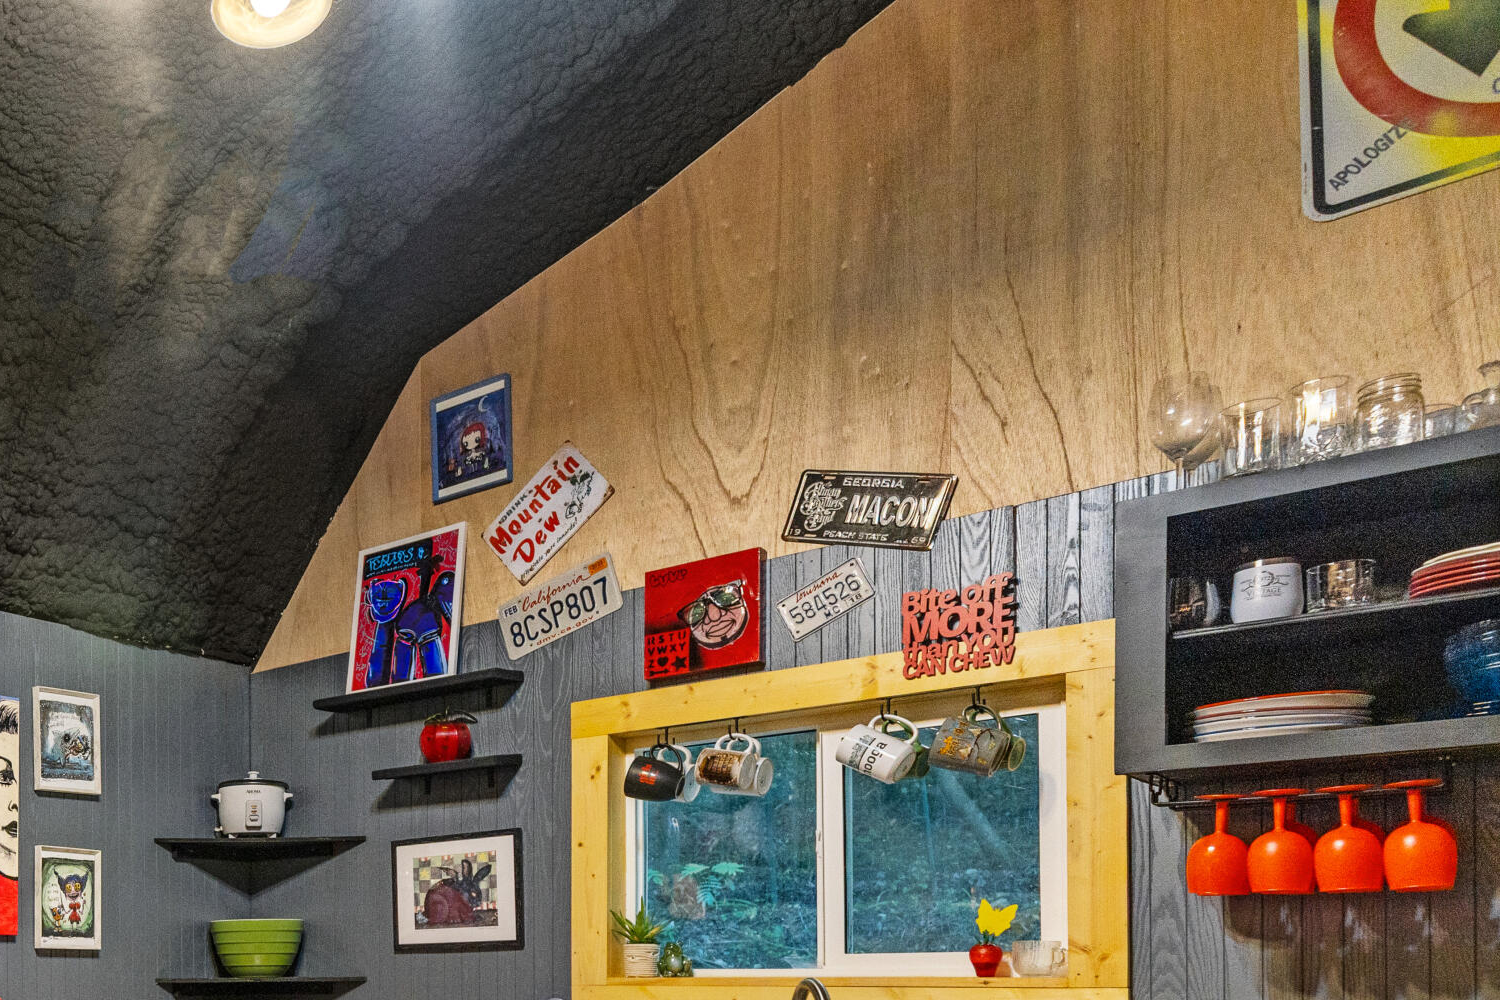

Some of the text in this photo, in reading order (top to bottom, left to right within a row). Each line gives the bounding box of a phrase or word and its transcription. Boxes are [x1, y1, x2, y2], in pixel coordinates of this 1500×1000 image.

[842, 477, 904, 489] GEORGIA
[489, 456, 580, 555] Mountain
[500, 494, 528, 524] DRINK
[844, 494, 934, 529] MACON
[512, 511, 561, 563] Dew
[823, 530, 854, 539] PEACH
[858, 533, 889, 541] STATE
[504, 574, 590, 617] FEB California
[789, 574, 861, 624] 584526
[796, 572, 843, 604] Louisiana
[901, 571, 1014, 616] Bite off
[510, 576, 608, 648] 8CSP807
[536, 616, 594, 646] dmv.ca.gov
[902, 596, 1015, 645] MORE
[902, 625, 1015, 668] than YOU
[903, 645, 1016, 680] CAN CHEW
